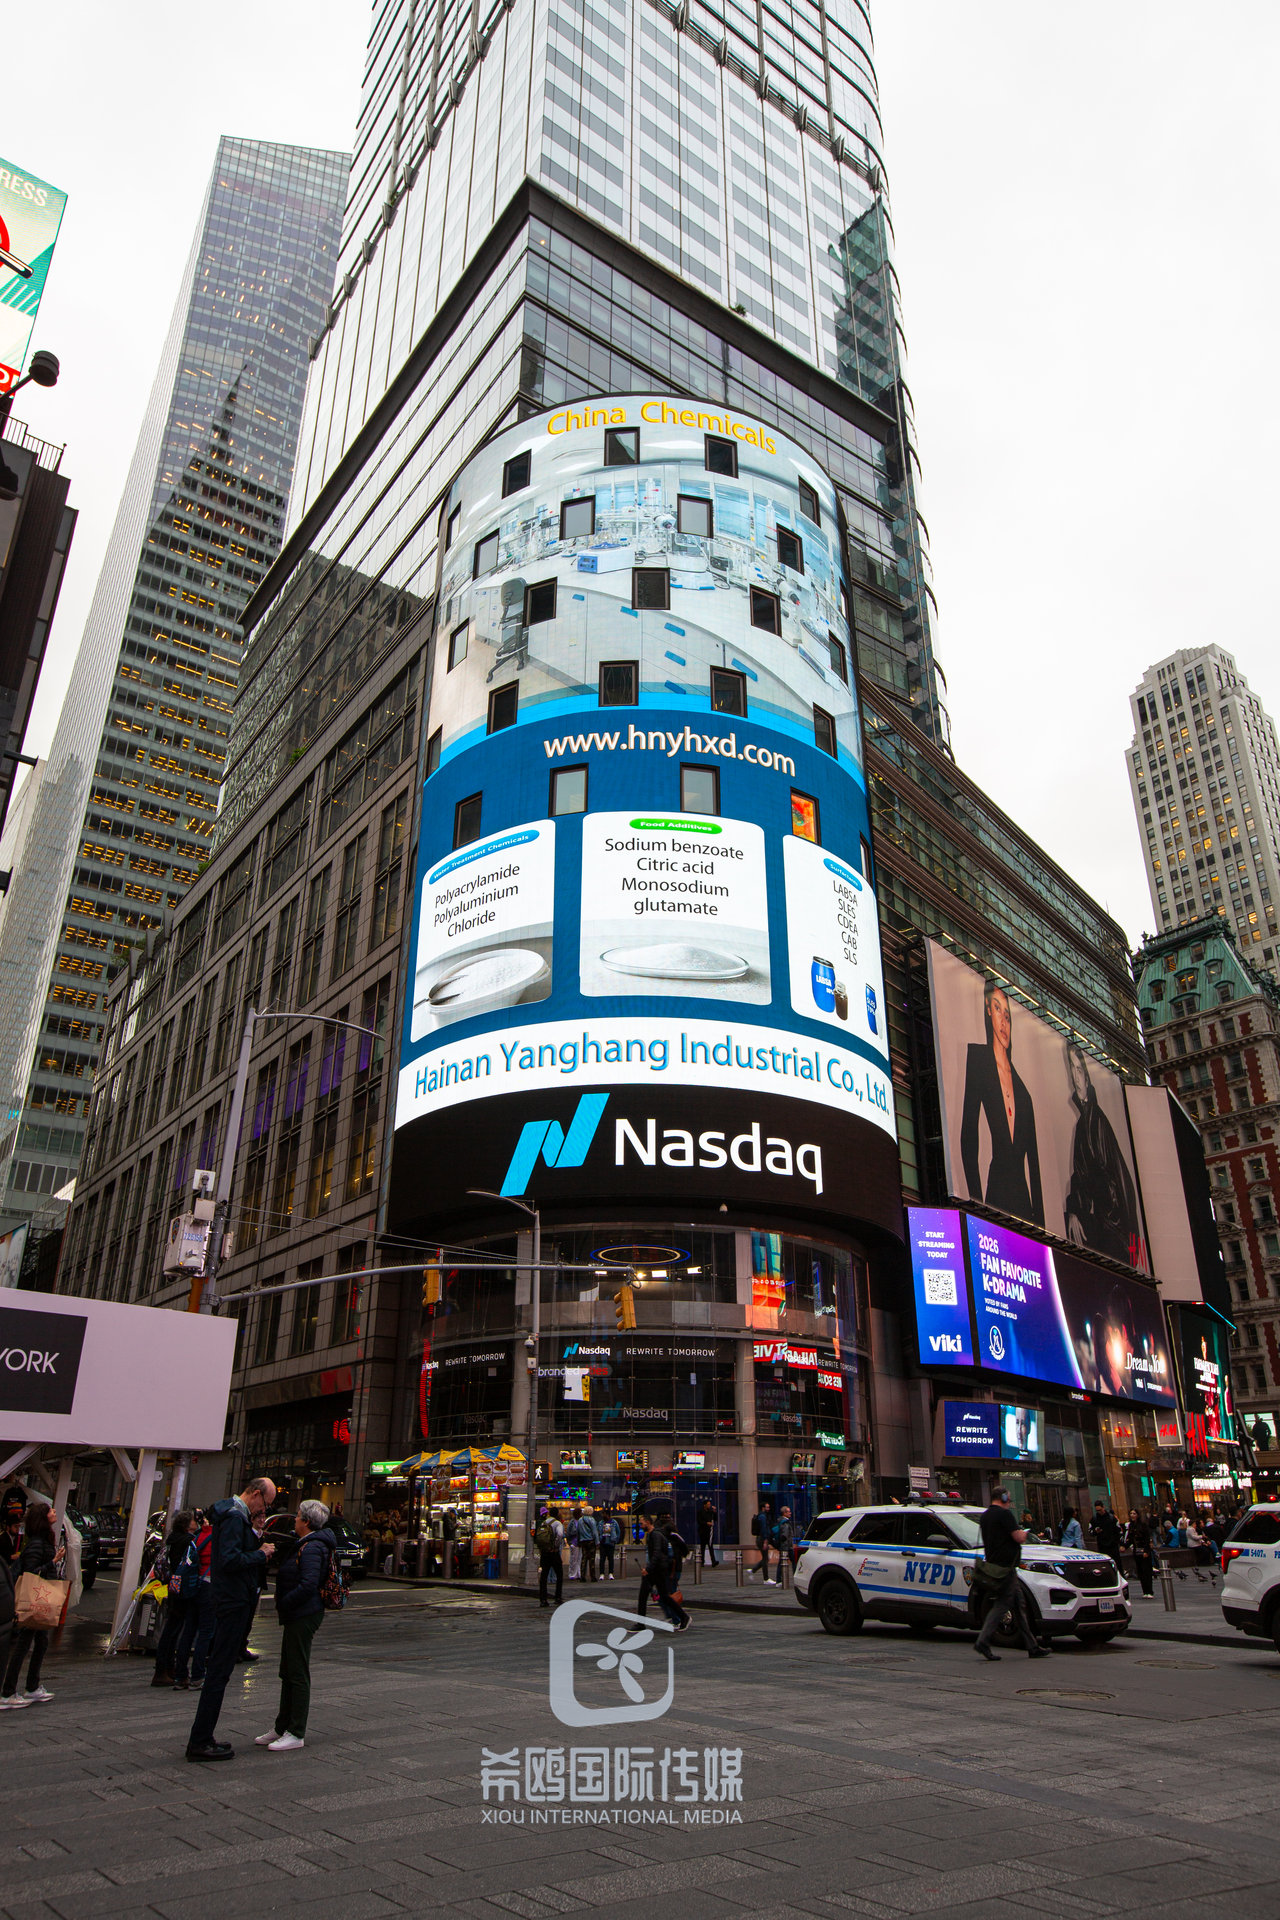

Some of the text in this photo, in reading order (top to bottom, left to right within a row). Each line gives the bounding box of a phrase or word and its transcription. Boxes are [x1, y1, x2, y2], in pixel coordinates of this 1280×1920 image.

[547, 401, 777, 456] China Chemicals
[543, 724, 796, 778] www.hnyhxd.com
[668, 822, 713, 831] Additives
[451, 849, 486, 867] Treatment
[488, 835, 529, 852] Chemicals
[605, 838, 744, 860] Sodium benzoate
[637, 857, 714, 875] Citric acid
[435, 864, 520, 908] Polyacrylamide
[622, 877, 729, 897] Monosodium
[833, 880, 858, 907] LABSA
[434, 884, 519, 927] Polyaluminium
[634, 897, 718, 915] glutamate
[838, 898, 856, 919] SLES
[447, 909, 496, 938] Chloride
[837, 913, 858, 937] CDEA
[841, 931, 857, 950] CAB
[843, 947, 857, 965] SLS
[415, 1031, 890, 1116] Hainan Yanghang Industrial Co., Ltd.
[615, 1118, 823, 1196] Nasdaq
[918, 1240, 955, 1249] STREAMING
[925, 1231, 944, 1239] START
[978, 1233, 999, 1255] 2026
[926, 1251, 948, 1259] TODAY
[980, 1252, 1042, 1289] FAN FAVORITE
[982, 1273, 1026, 1303] K-DRAMA
[579, 1346, 716, 1357] Nasdaq REWRITE TOMORROW
[929, 1334, 962, 1352] Viki
[445, 1356, 467, 1366] REWRITE
[469, 1352, 505, 1363] TOMORROW
[818, 1359, 838, 1368] REWRITE
[1124, 1352, 1148, 1373] Dream
[623, 1407, 668, 1421] Nasdaq
[951, 1436, 994, 1444] TOMORROW
[956, 1426, 988, 1434] REWRITE
[903, 1560, 956, 1587] NYPD
